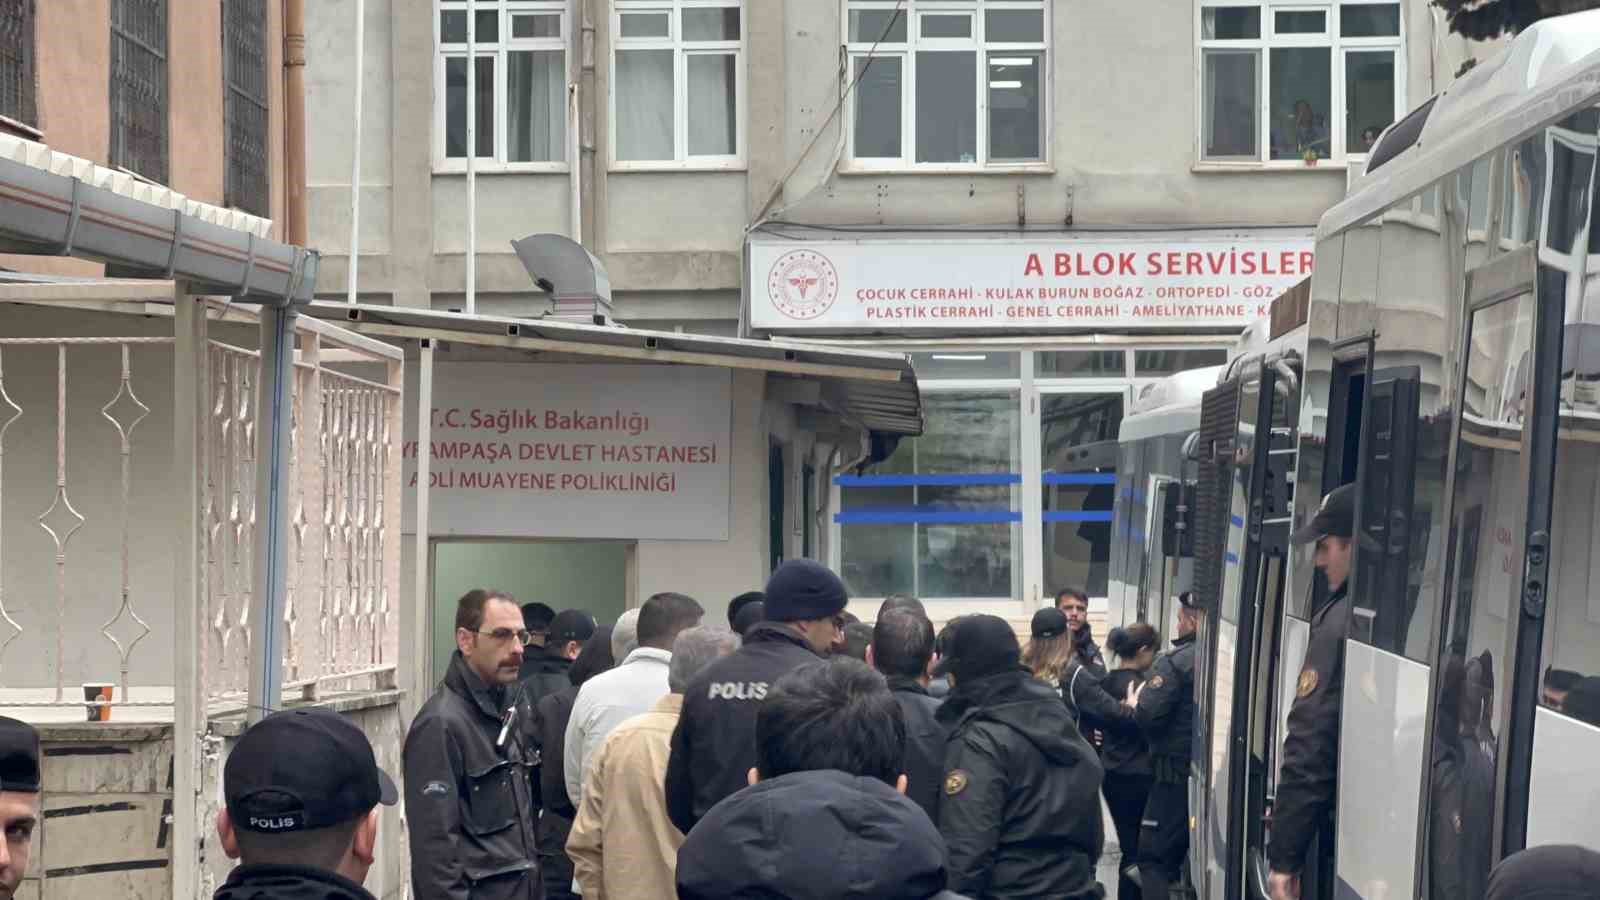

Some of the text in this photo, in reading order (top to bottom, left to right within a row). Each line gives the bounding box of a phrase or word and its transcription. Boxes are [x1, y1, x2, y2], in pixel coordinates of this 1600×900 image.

[1023, 252, 1044, 277] A
[1053, 251, 1138, 277] BLOK
[856, 284, 1274, 303] ÇOCUK CERRAHİ KULAK BURUN BOĞAZ ORTOPEDİ GÖZ
[866, 303, 927, 319] PLASTİK
[930, 303, 994, 319] CERRAHİ
[1006, 305, 1053, 318] GENEL
[1056, 303, 1120, 317] CERRAHİ
[1131, 302, 1245, 317] AMELİYATHANE
[470, 407, 538, 434] Sağlık
[543, 409, 651, 437] Bakanlığı
[518, 443, 597, 462] DEVLET
[600, 442, 718, 464] HASTANESİ
[459, 471, 556, 490] MUAYENE
[561, 469, 677, 493] POLİKLİNİĞİ
